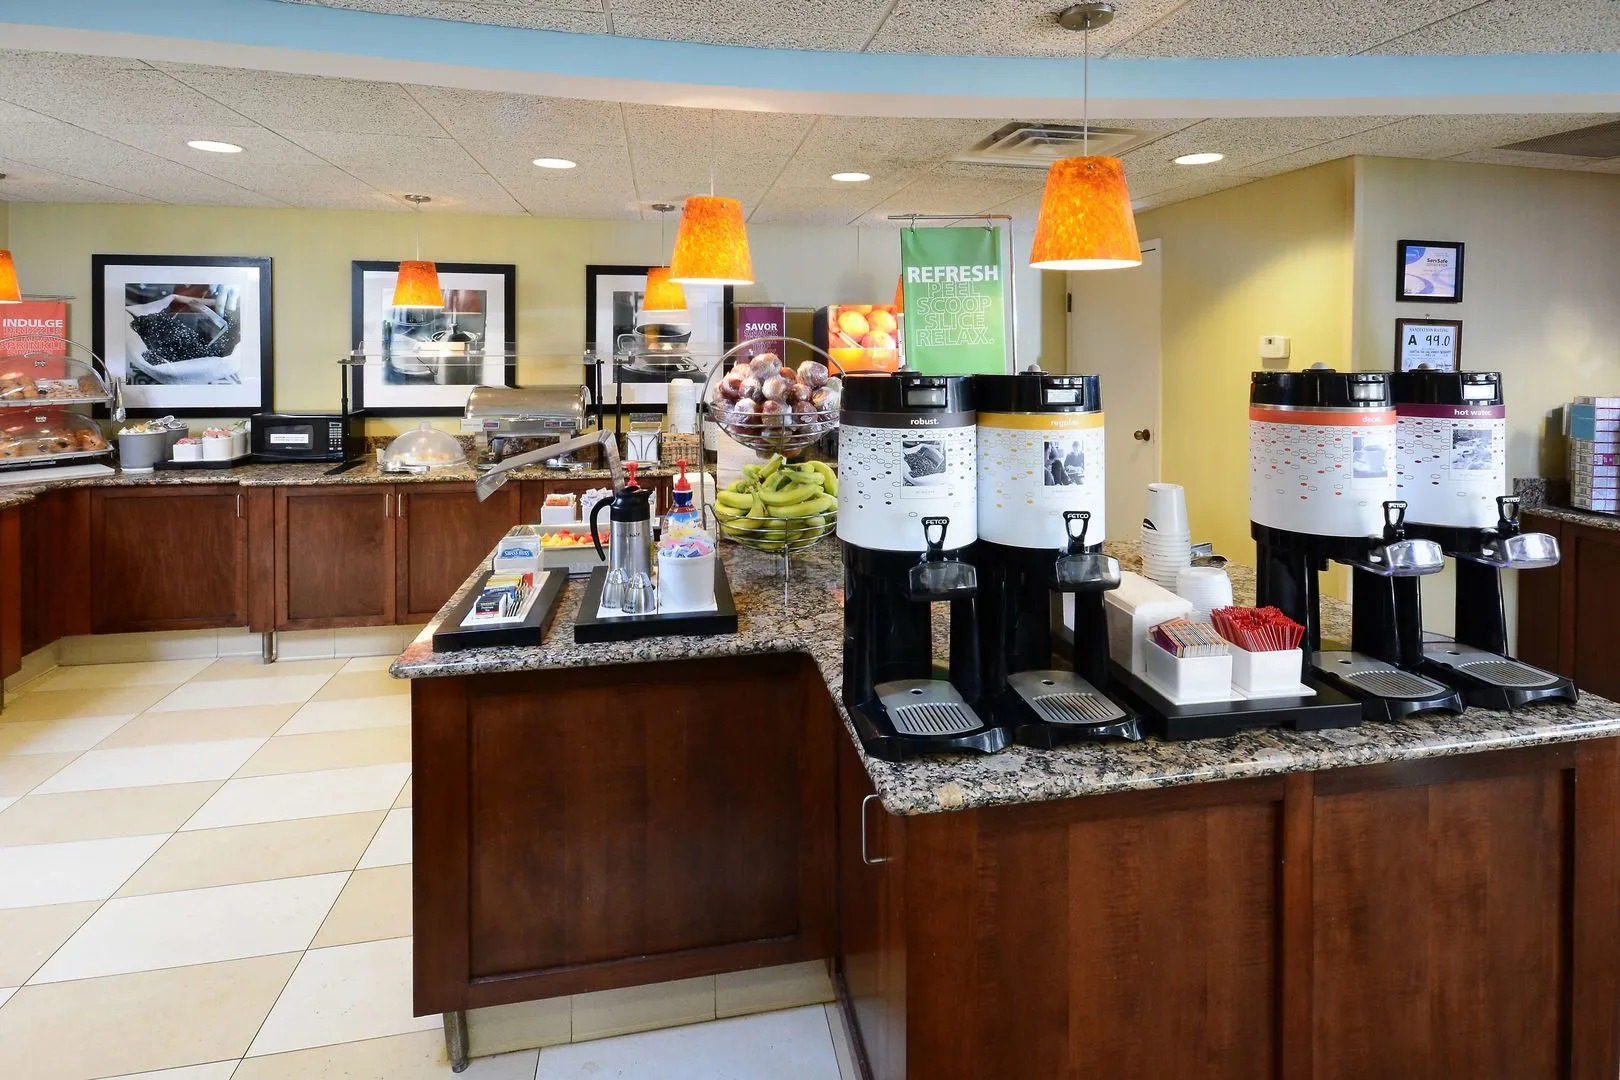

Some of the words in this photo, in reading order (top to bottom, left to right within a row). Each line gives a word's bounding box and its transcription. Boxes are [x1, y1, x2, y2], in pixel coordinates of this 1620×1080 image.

[907, 265, 998, 283] REFRESH
[928, 281, 981, 298] PEEL
[917, 296, 992, 314] SCOOP
[3, 319, 63, 328] INDULGE
[924, 313, 985, 330] SLICE
[916, 328, 994, 346] RELAX.
[1408, 334, 1417, 345] A
[1425, 335, 1450, 346] 99.0
[1454, 408, 1469, 416] hot
[910, 417, 939, 426] robust.
